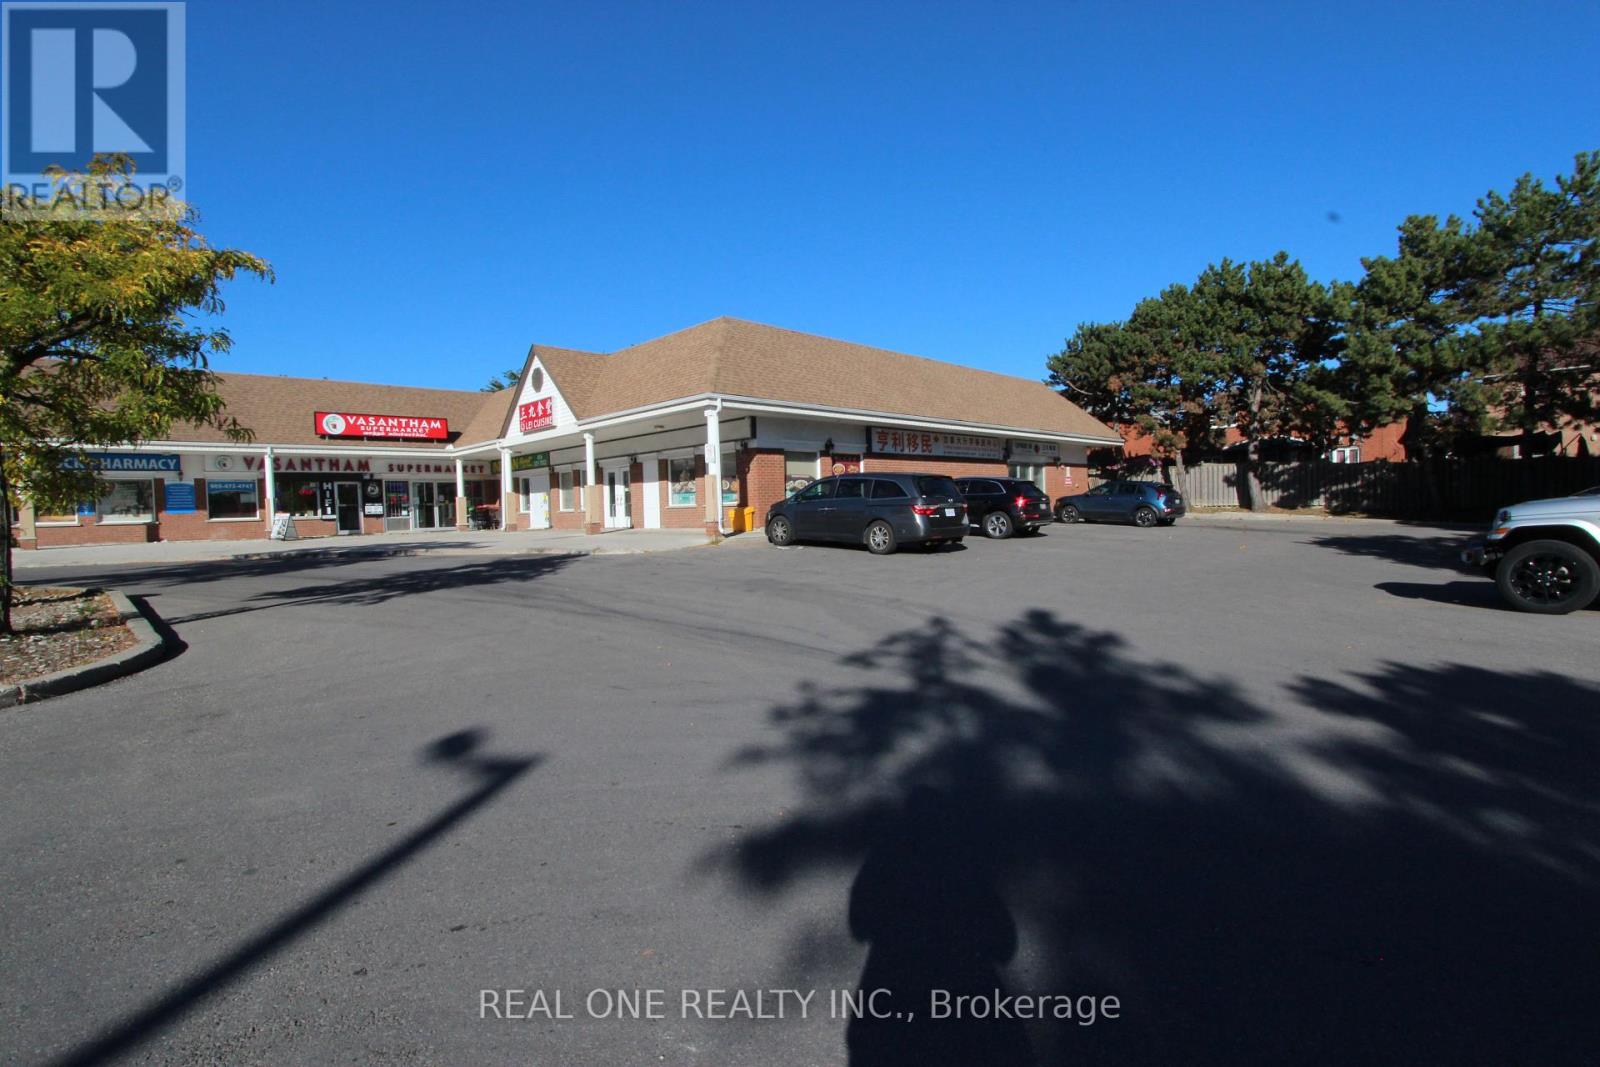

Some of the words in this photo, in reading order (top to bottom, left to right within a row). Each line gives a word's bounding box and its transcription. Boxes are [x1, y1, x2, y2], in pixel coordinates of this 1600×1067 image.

[346, 416, 441, 429] VASANTHAM
[360, 425, 430, 433] SUPERMARKET
[91, 458, 177, 470] HARMACY
